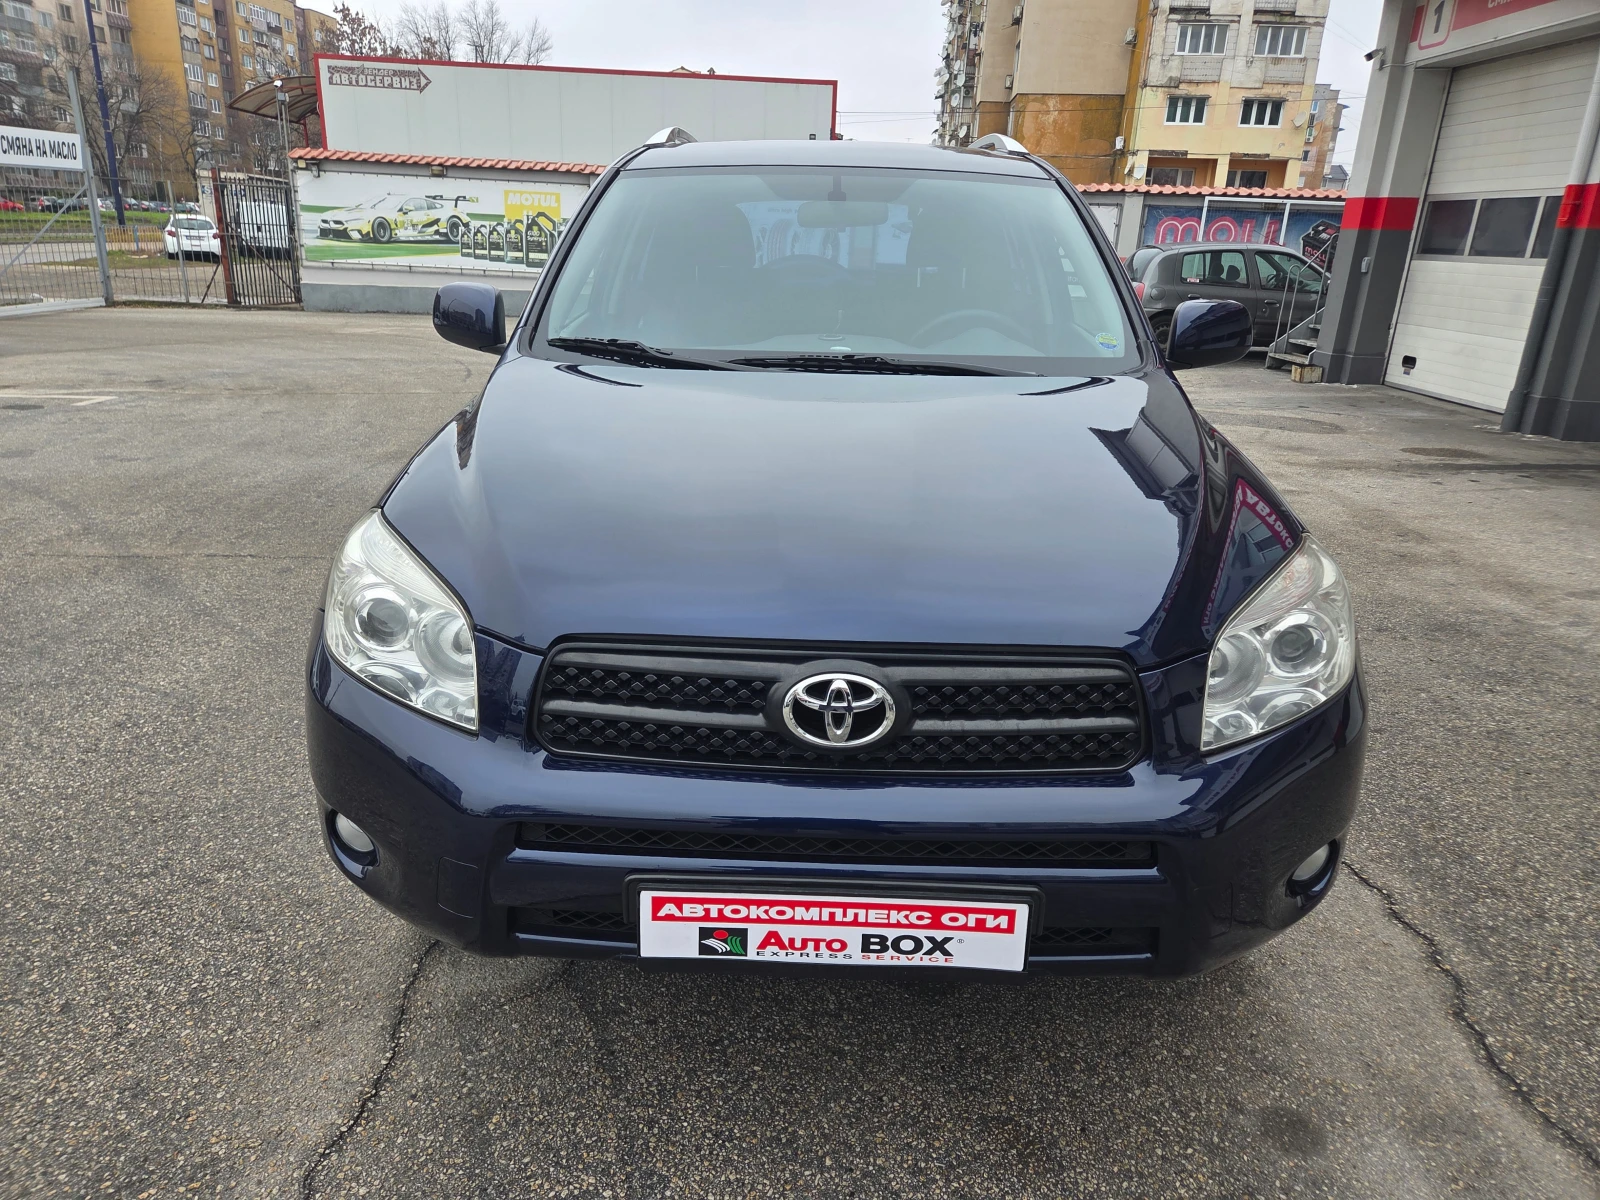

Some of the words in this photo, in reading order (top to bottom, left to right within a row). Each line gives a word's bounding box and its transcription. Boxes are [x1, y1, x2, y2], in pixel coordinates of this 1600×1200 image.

[1433, 0, 1446, 34] 1
[333, 73, 418, 89] АВТОСЕРВИЗ
[0, 135, 34, 157] СМЯНА
[35, 138, 48, 158] НА
[48, 139, 78, 160] МАСЛО
[507, 192, 559, 207] MOTUL
[655, 902, 933, 926] АВТОКОМПЛЕКС
[940, 911, 1009, 930] ОГИ
[756, 950, 853, 960] EXPRESS
[861, 953, 955, 964] SERVICE
